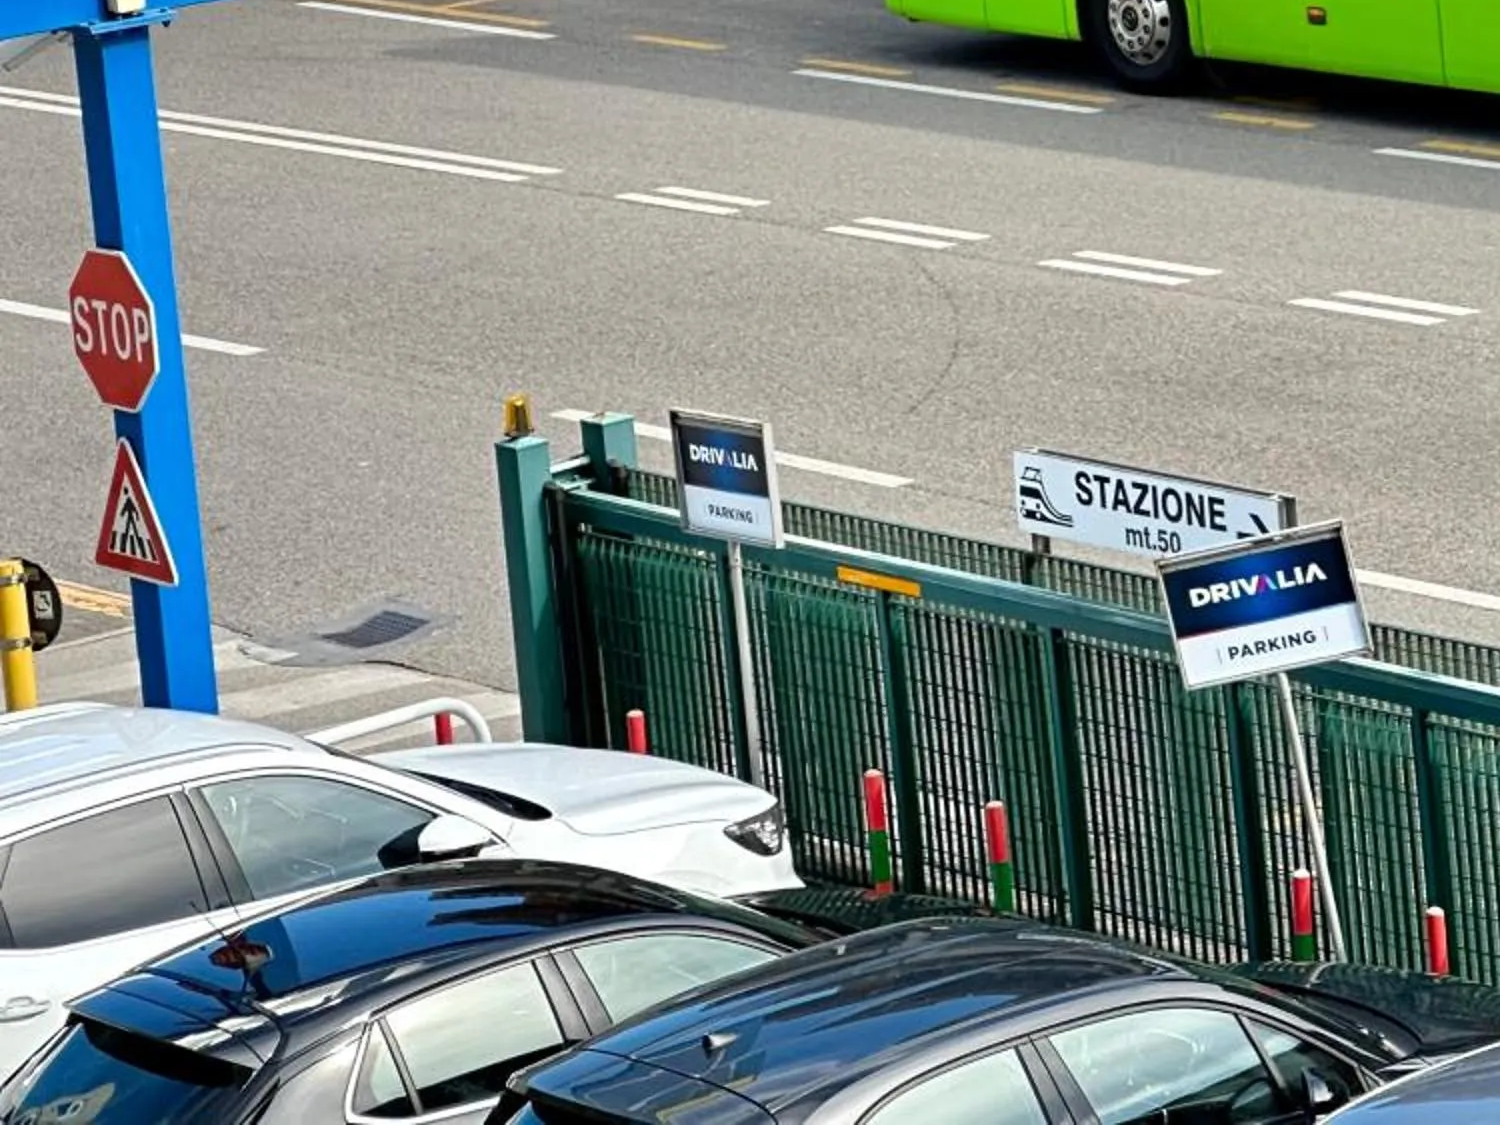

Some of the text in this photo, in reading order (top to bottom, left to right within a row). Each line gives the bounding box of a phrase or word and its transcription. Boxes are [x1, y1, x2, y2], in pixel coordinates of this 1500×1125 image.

[72, 296, 151, 363] STOP
[689, 443, 759, 472] DRIVALIA
[708, 503, 753, 524] PARKING
[1074, 470, 1228, 532] STAZIONE
[1125, 526, 1182, 554] mt.50
[1188, 562, 1328, 608] DRIVALIA
[1227, 630, 1317, 660] PARKING
